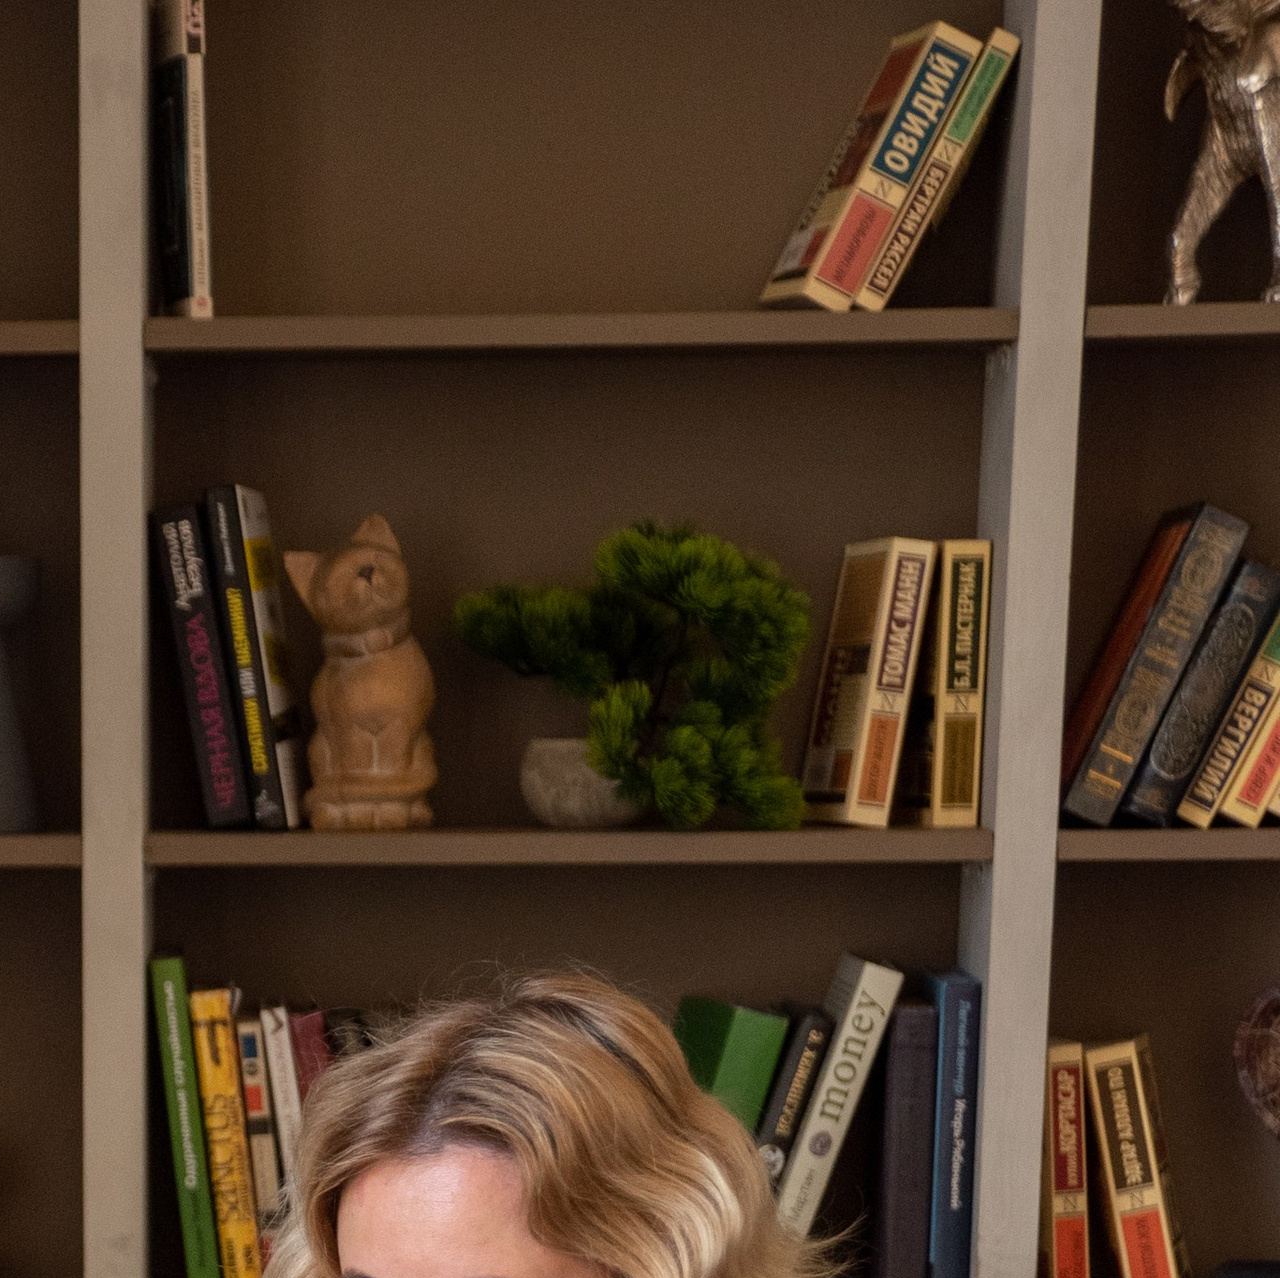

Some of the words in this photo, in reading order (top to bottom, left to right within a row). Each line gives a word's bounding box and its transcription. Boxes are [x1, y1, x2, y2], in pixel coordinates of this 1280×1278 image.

[880, 46, 965, 177] ОВИДИЙ
[900, 165, 945, 234] БЕРТРАН
[871, 230, 912, 290] РАССЕЛ
[161, 521, 192, 611] Анатолий
[891, 559, 922, 620] МАНН
[956, 559, 977, 652] ПАСТЕРНАК
[183, 613, 220, 703] ВДОВА
[238, 667, 257, 697] ИЛИ
[880, 620, 912, 687] ТОМАС
[199, 706, 238, 808] ЧЕРНАЯ
[243, 697, 269, 774] СОРАТНИКИ
[1193, 684, 1267, 804] ВЕРГИЛИЙ
[160, 979, 187, 1087] случайностью
[816, 987, 885, 1125] money
[1056, 1068, 1076, 1152] КОРТАСАР
[1106, 1066, 1125, 1088] ПО
[1111, 1089, 1134, 1139] АЛЛАН
[173, 1089, 201, 1190] Одураченные
[1119, 1141, 1144, 1185] ЭДГАР
